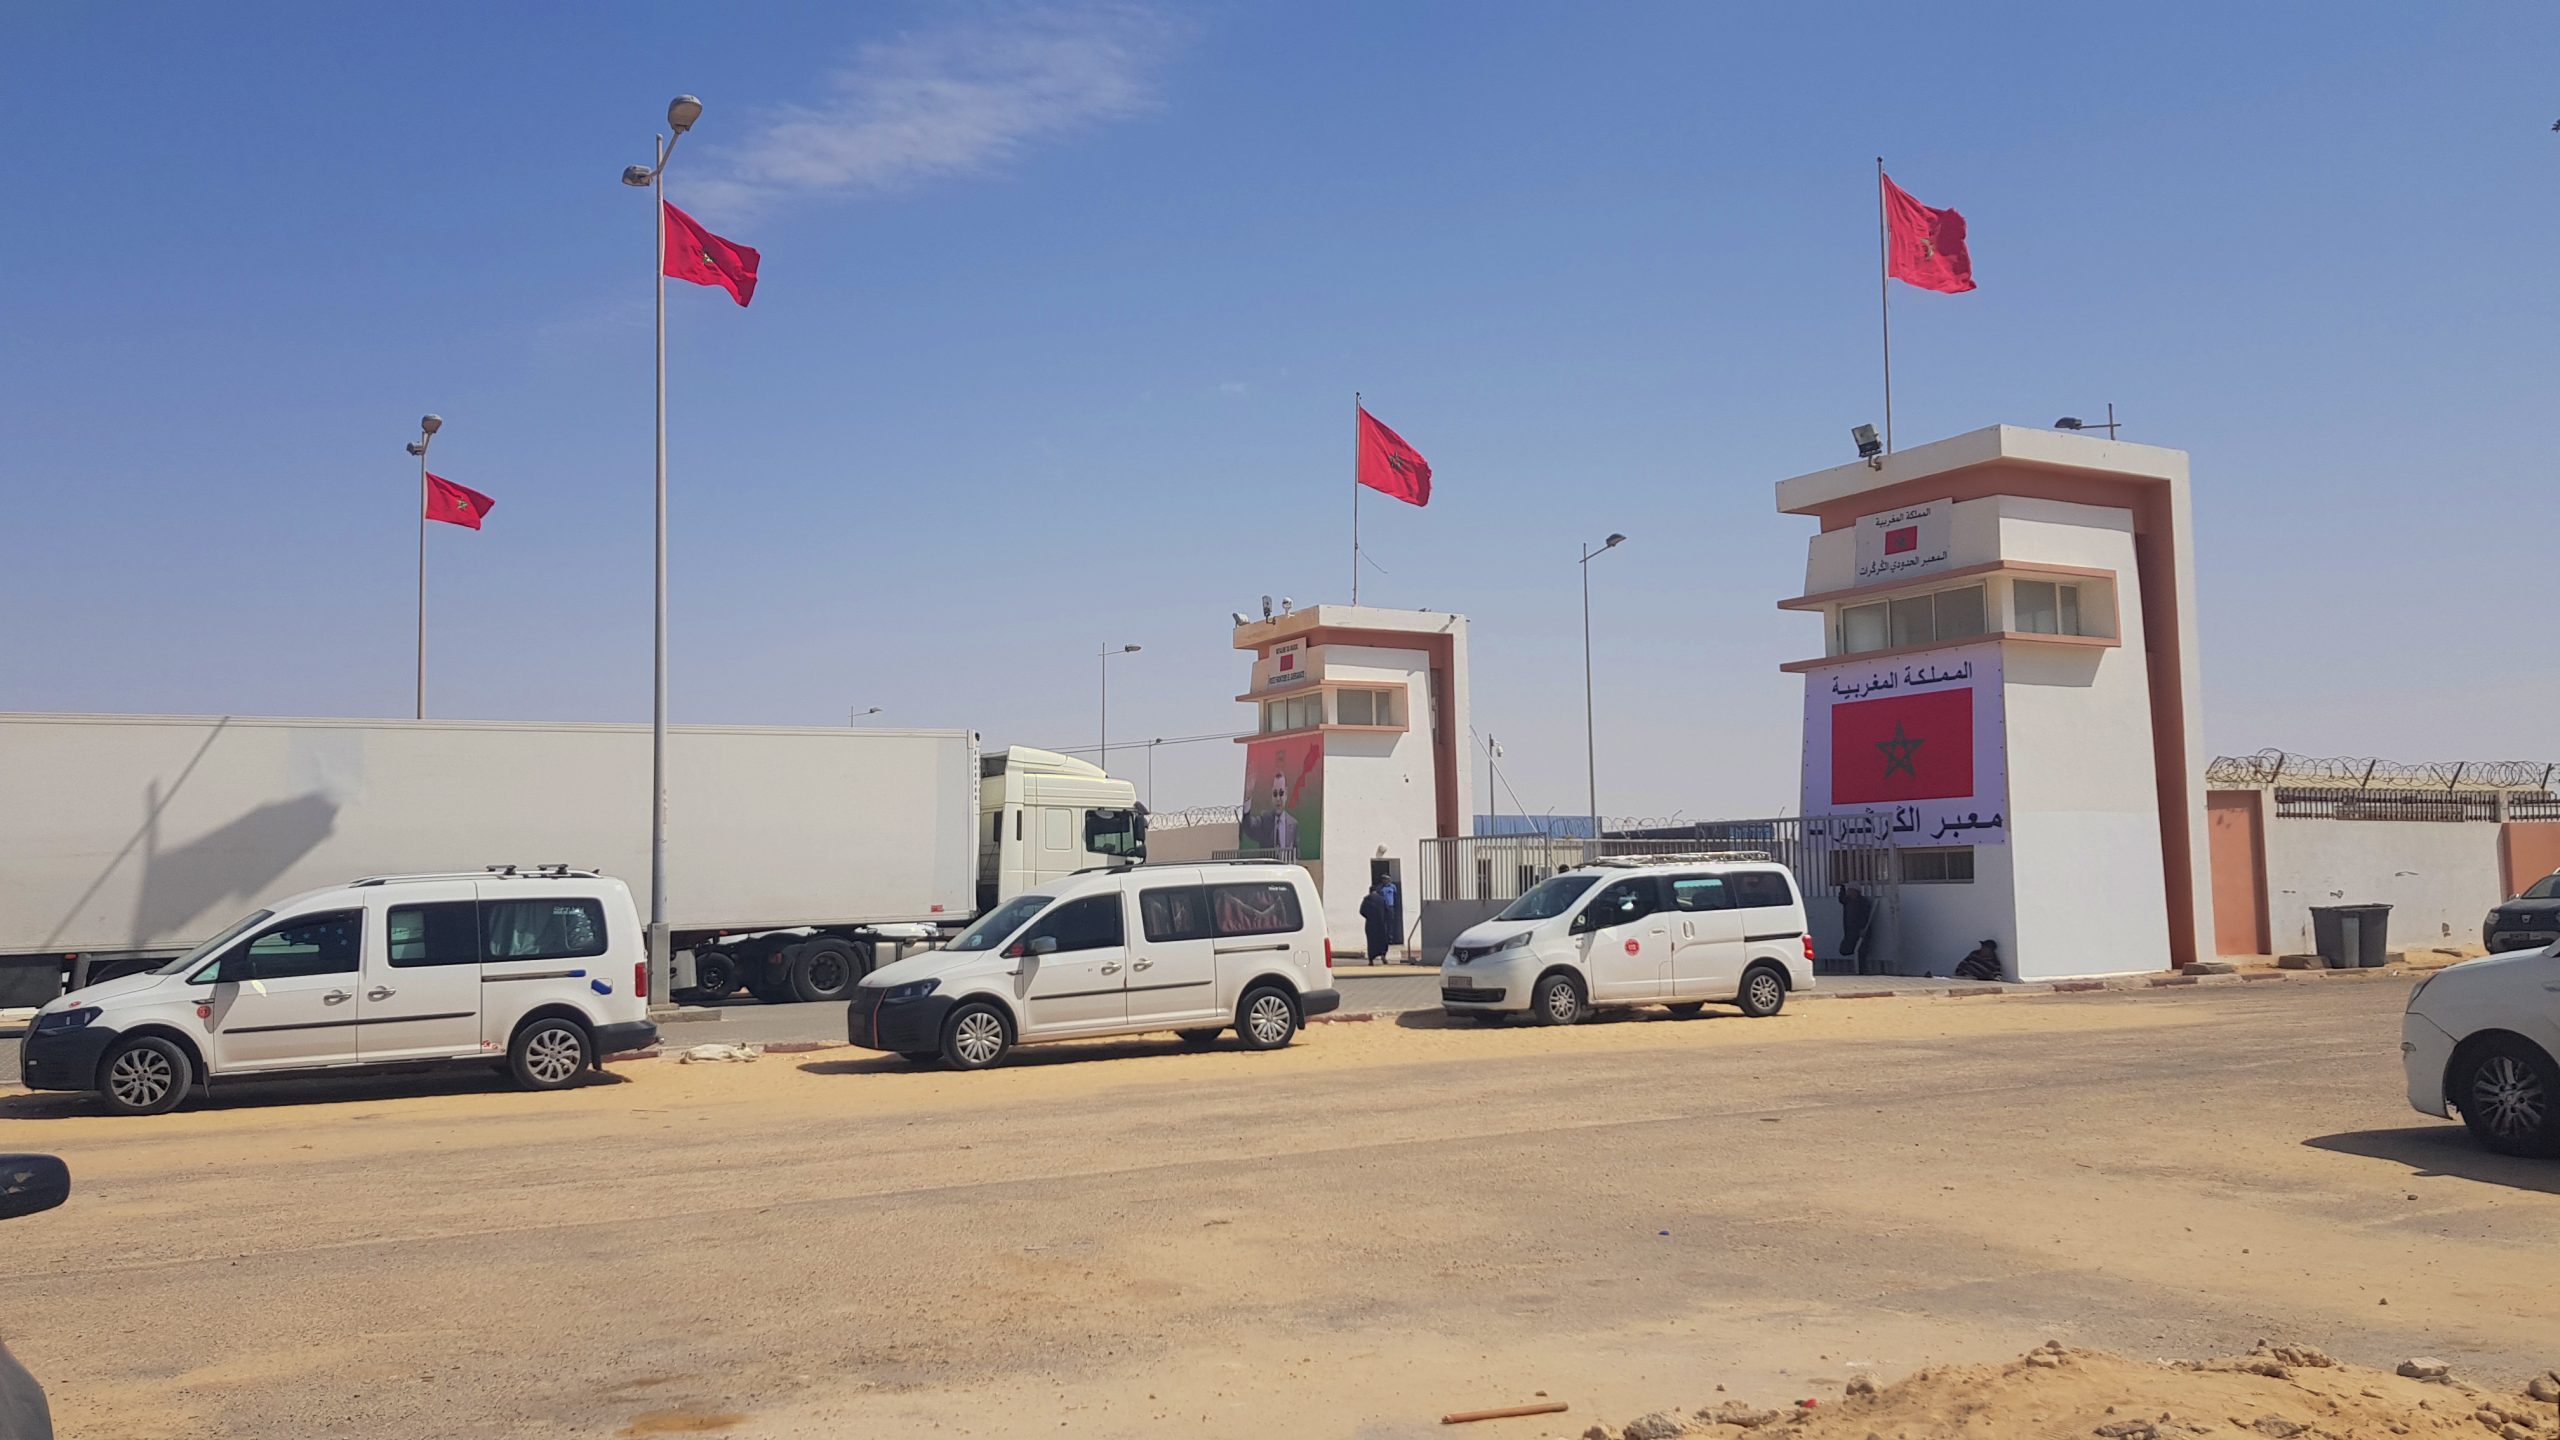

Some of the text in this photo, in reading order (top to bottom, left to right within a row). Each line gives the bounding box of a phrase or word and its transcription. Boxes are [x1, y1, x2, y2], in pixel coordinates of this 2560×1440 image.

[1875, 507, 1931, 528] المملكة المغربية
[1920, 551, 1948, 567] المعبر
[1832, 660, 1973, 699] المملكة المغربية
[1930, 812, 2003, 840] معبر
